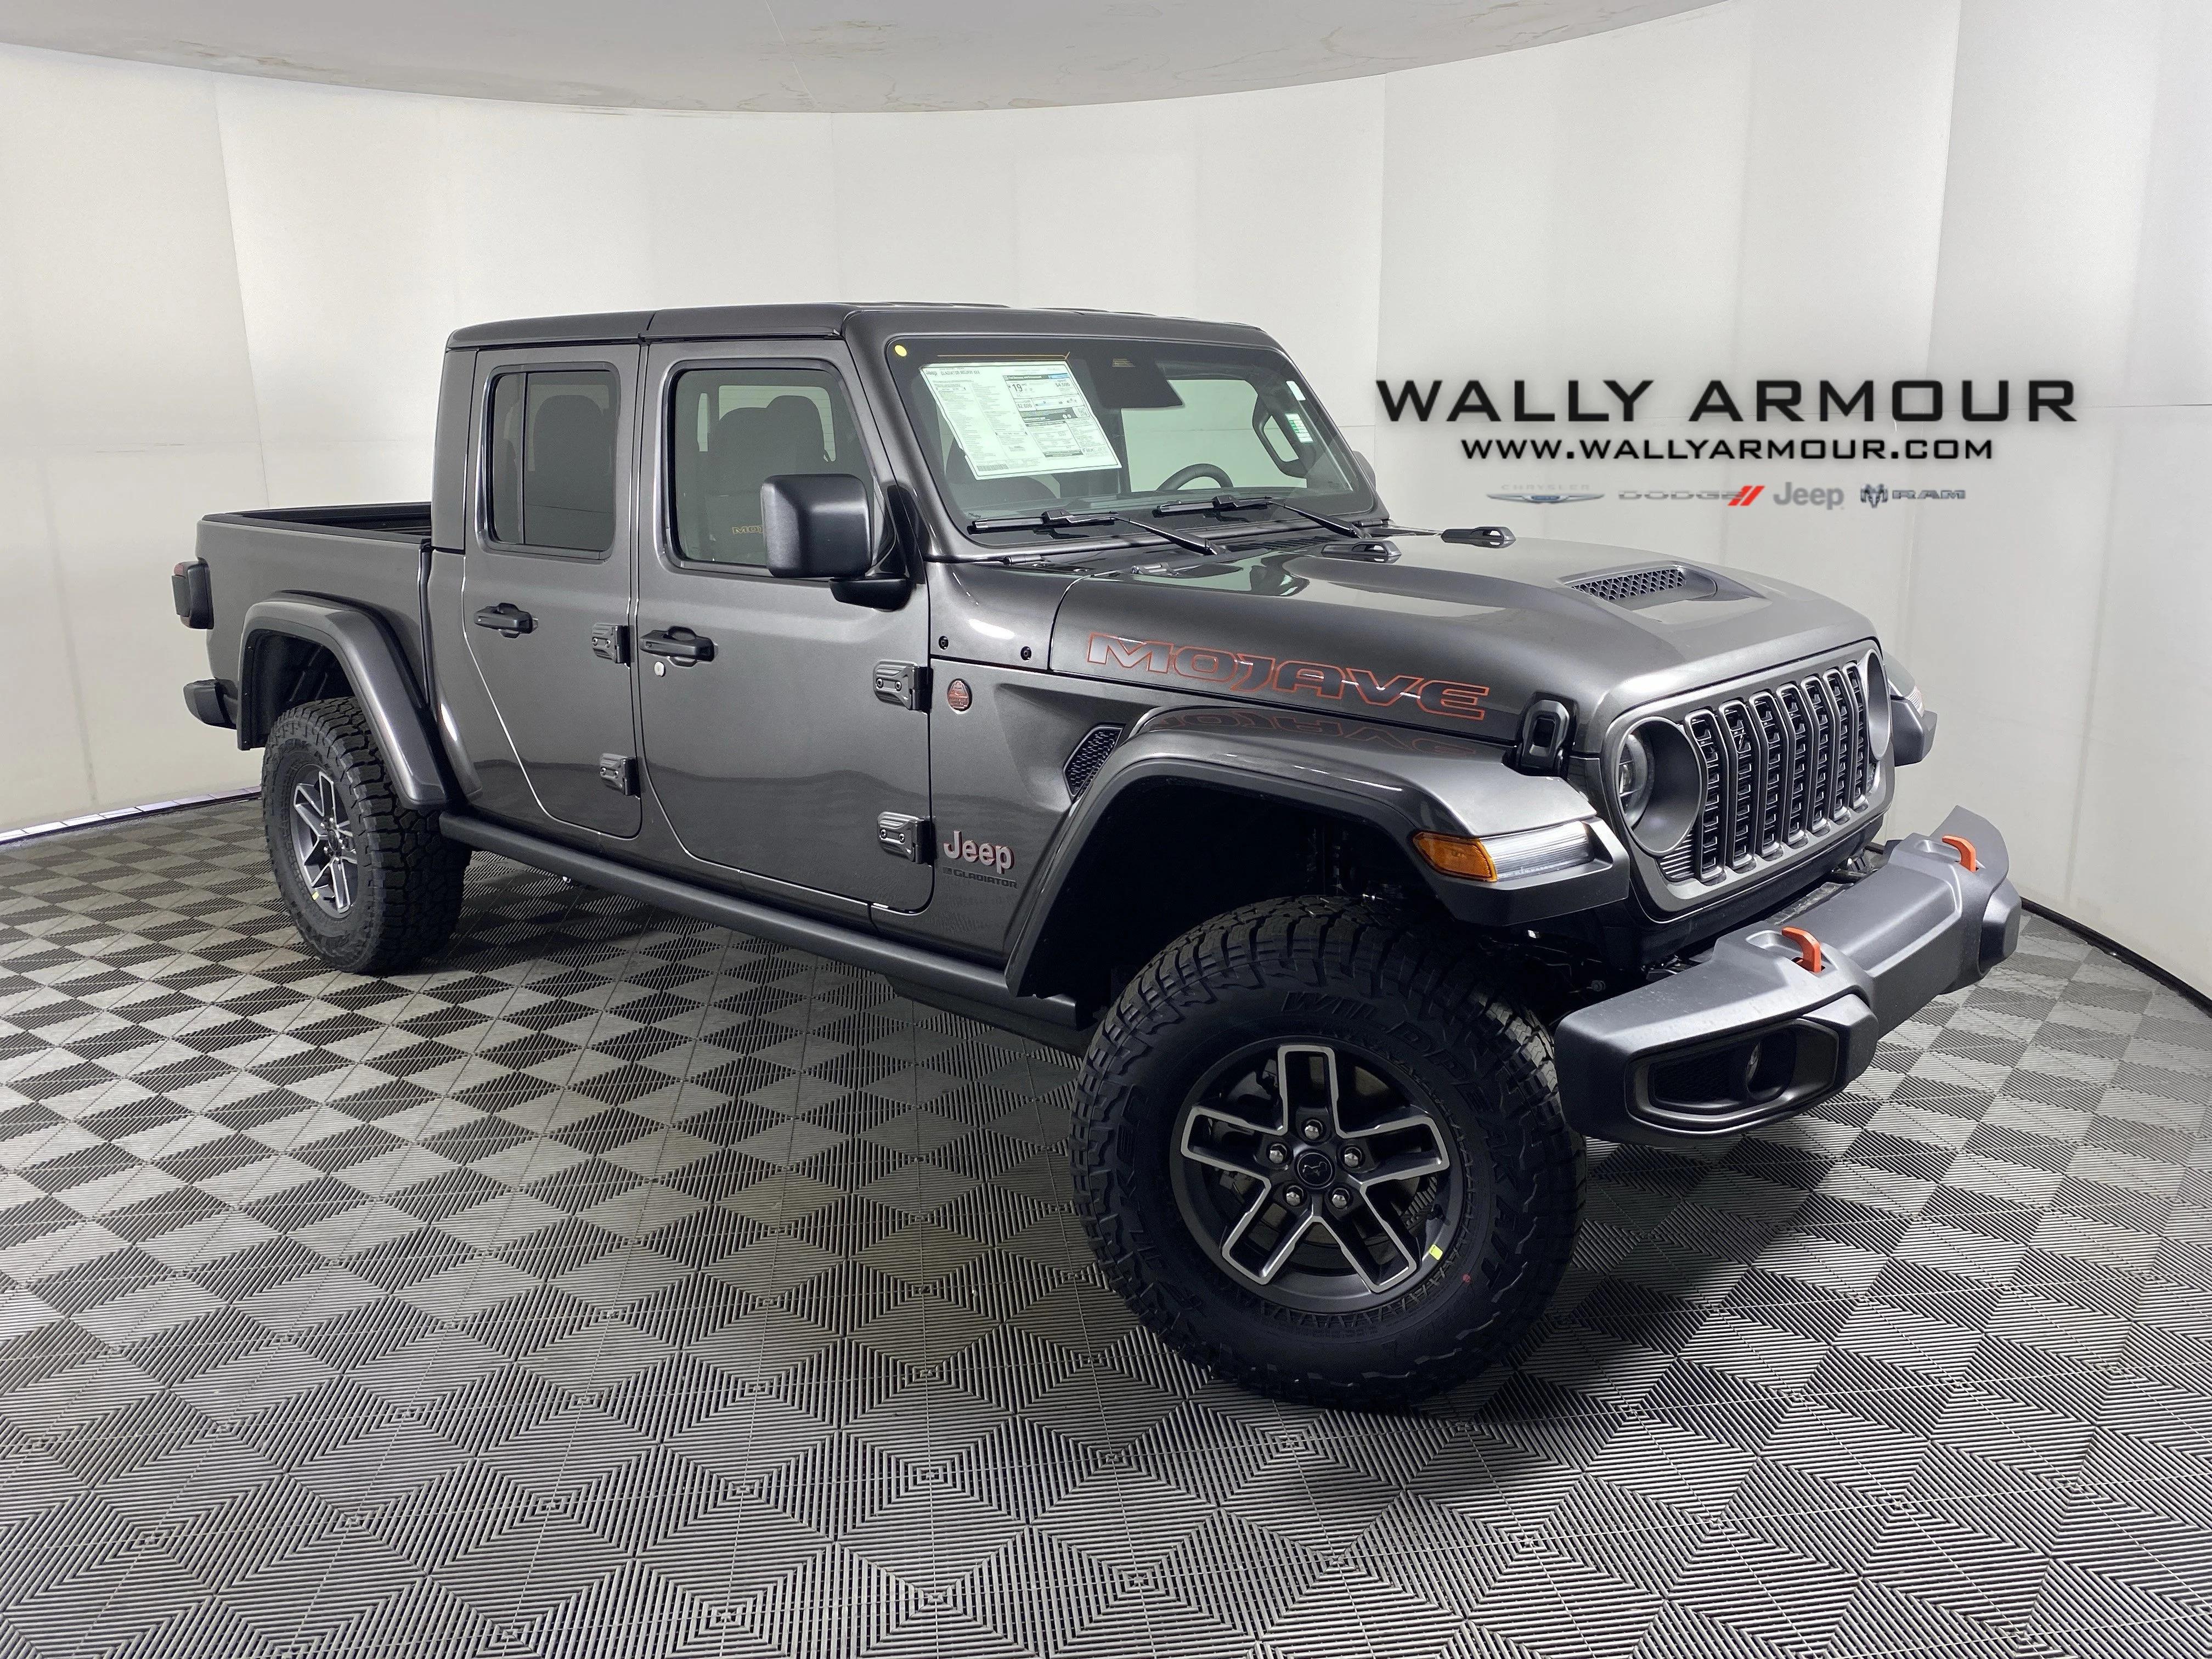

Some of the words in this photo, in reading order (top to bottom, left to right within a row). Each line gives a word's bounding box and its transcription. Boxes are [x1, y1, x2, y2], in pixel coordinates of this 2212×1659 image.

[1087, 632, 1490, 720] MOJAVE
[943, 830, 1014, 874] Jeep
[953, 869, 1018, 889] GLADIATOR
